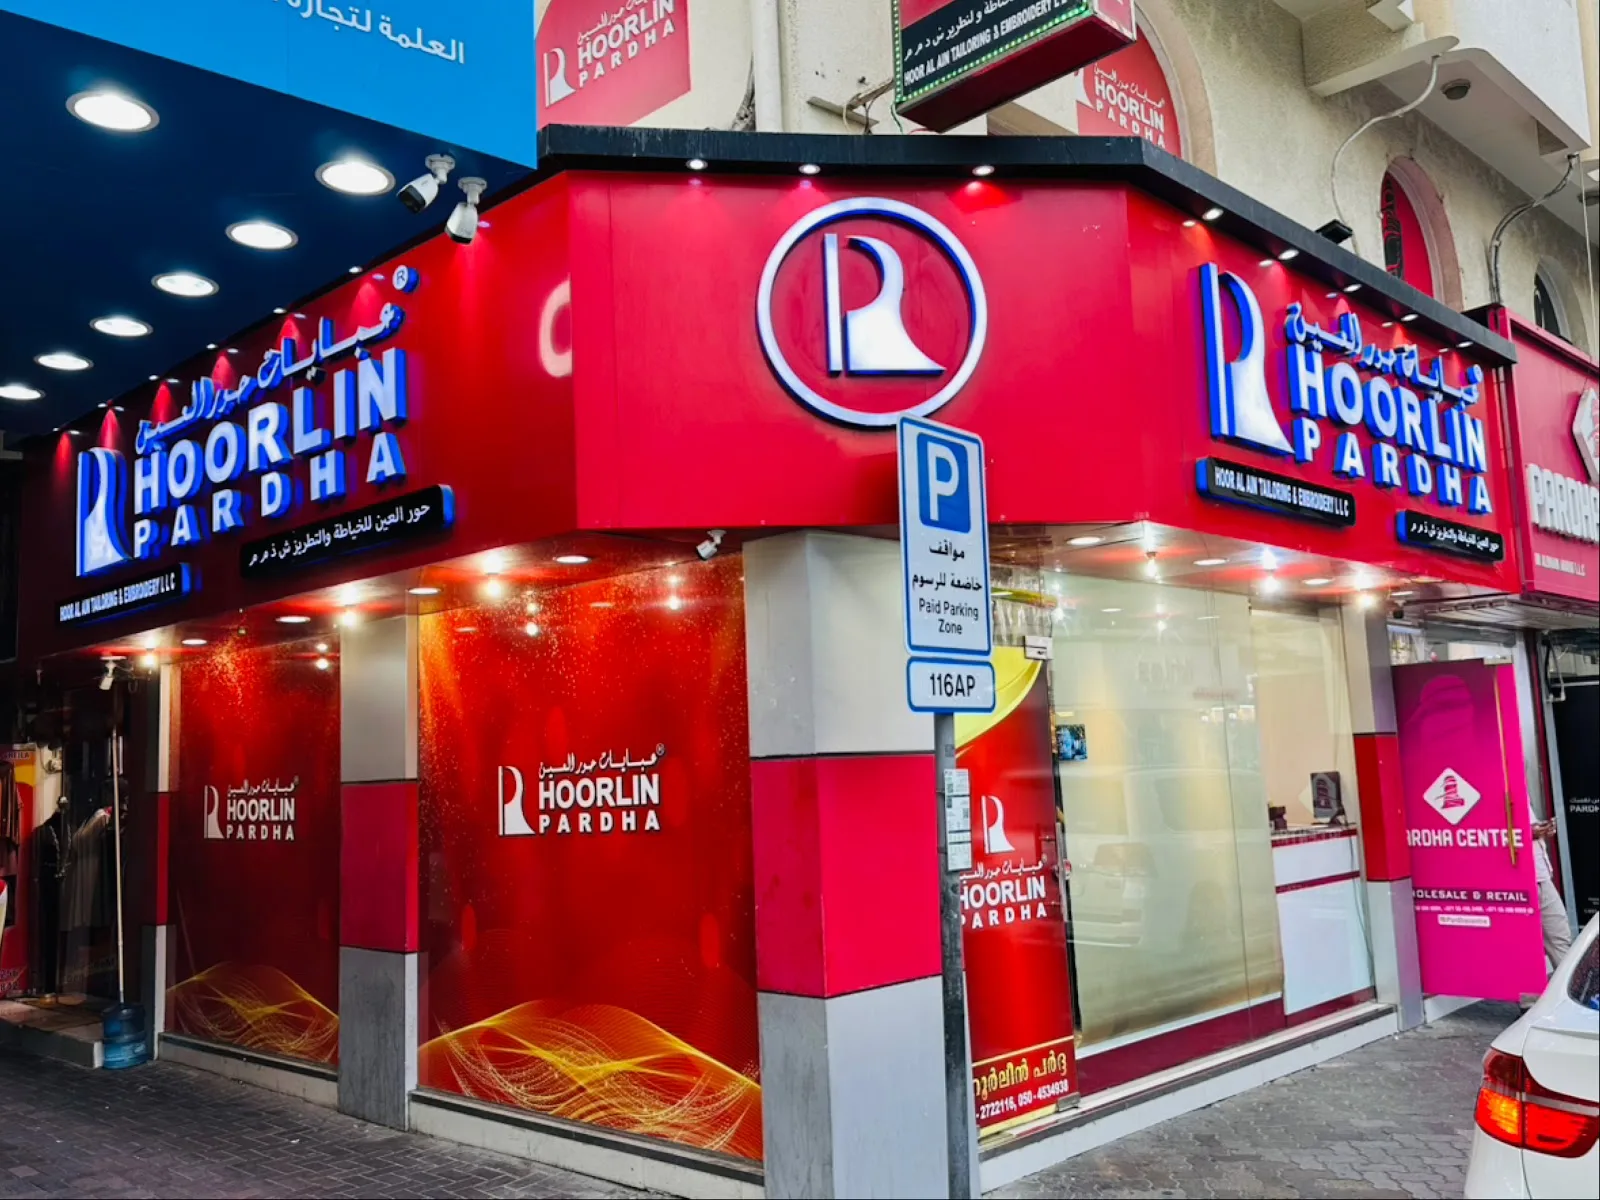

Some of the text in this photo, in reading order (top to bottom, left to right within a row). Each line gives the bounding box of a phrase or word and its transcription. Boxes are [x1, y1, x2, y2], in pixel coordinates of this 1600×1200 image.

[577, 0, 675, 69] HOORLIN
[904, 63, 926, 87] HOOR
[926, 58, 936, 76] AL
[937, 50, 950, 71] AIN
[951, 28, 991, 62] TAILORING
[1000, 0, 1052, 36] EMBROIDERY
[578, 18, 676, 88] PARDHA
[1094, 75, 1165, 134] HOORLIN
[1096, 97, 1165, 149] PARDHA
[1287, 342, 1487, 473] HOORLIN
[134, 347, 406, 514] HOORLIN
[1293, 417, 1492, 514] PARDHA
[134, 432, 405, 559] PARDHA
[1214, 466, 1235, 488] HOOR
[1235, 472, 1245, 492] AL
[1258, 478, 1292, 503] TAILORING
[333, 515, 372, 540] للخياطة
[375, 505, 404, 532] العين
[406, 504, 431, 524] حور
[929, 539, 965, 562] مواقف
[912, 572, 982, 592] خاضعة للرسوم
[919, 598, 979, 621] Paid Parking
[938, 619, 963, 635] Zone
[930, 672, 976, 698] 116AP
[538, 773, 660, 810] HOORLIN
[227, 798, 295, 821] HOORLIN
[539, 810, 661, 834] PARDHA
[226, 824, 295, 841] PARDHA
[1486, 891, 1528, 902] RETAIL
